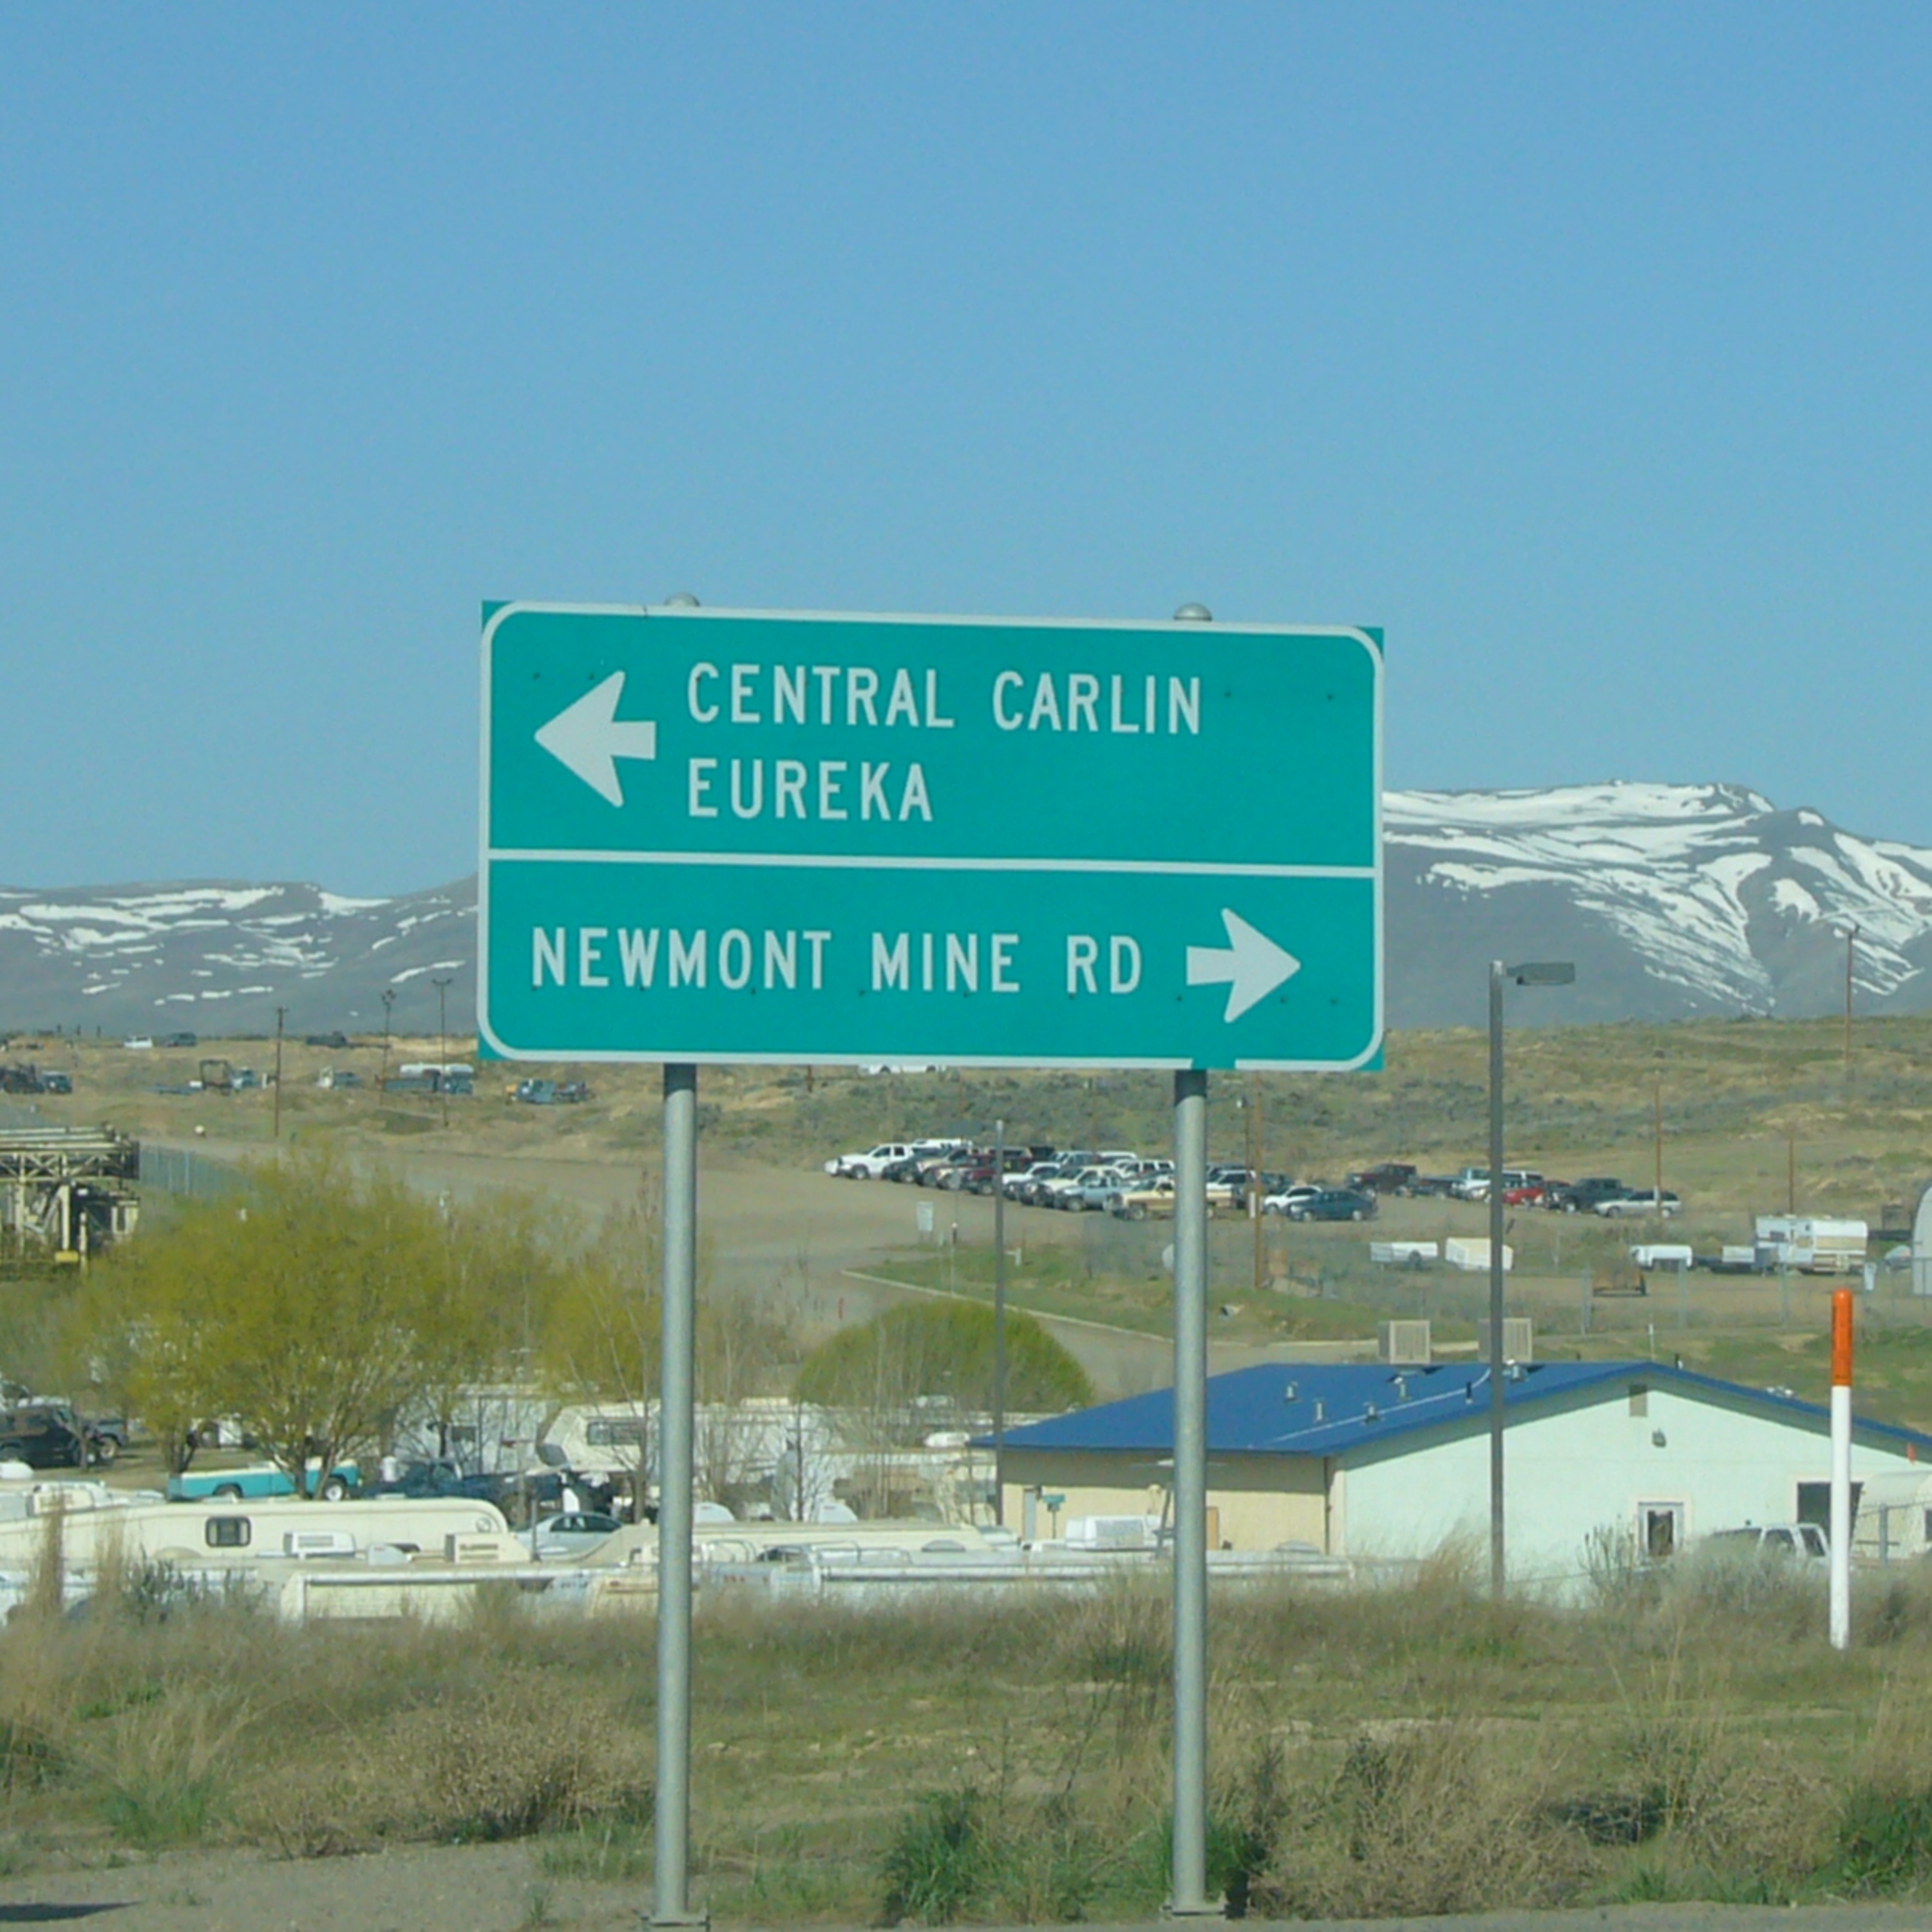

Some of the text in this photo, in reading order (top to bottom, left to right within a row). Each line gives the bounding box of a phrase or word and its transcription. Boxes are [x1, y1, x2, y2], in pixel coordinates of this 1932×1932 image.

[688, 663, 1199, 734] CENTRAL CARLIN
[689, 759, 932, 821] EUREKA
[533, 928, 1141, 993] NEWMONT MINE RD
